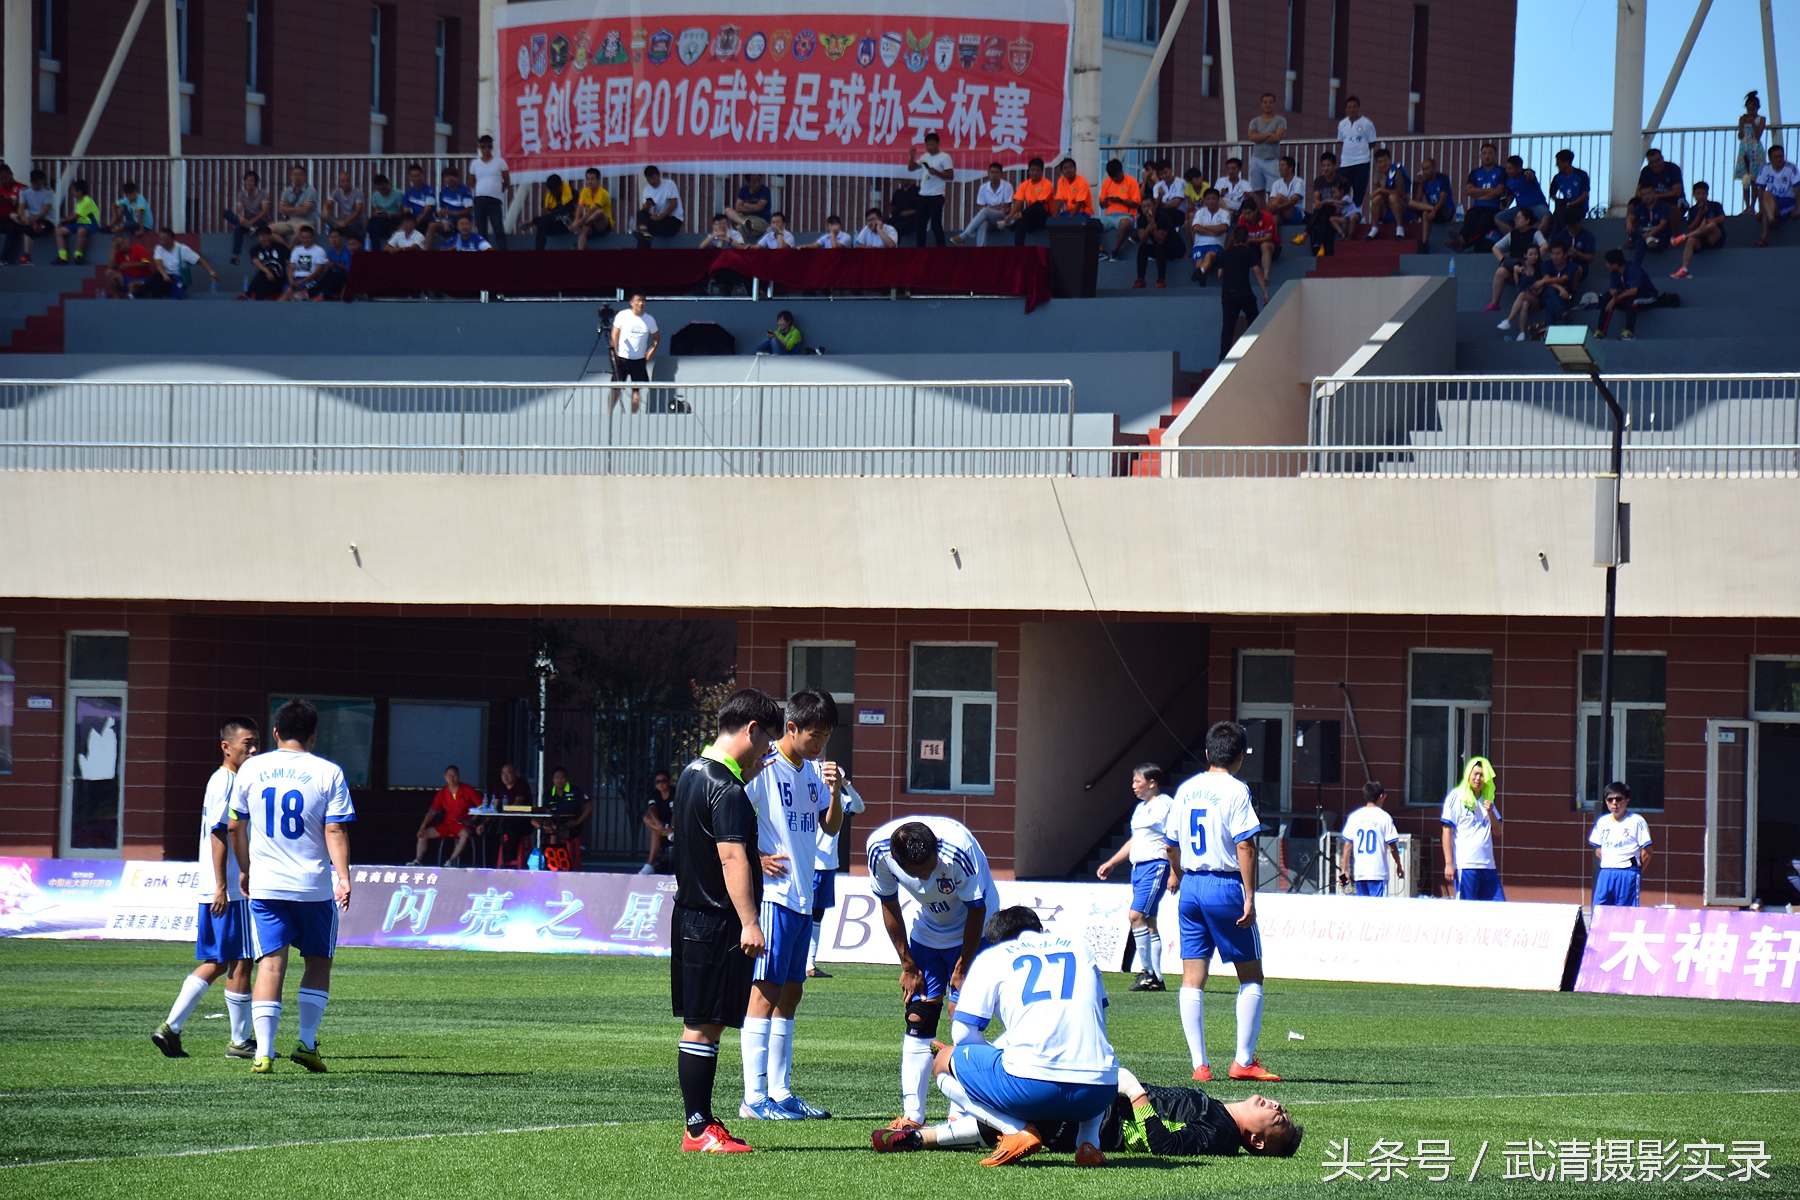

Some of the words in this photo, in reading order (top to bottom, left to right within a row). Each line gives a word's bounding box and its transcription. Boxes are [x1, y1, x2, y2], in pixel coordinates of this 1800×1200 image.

[516, 69, 1032, 156] 首创集团2016武清足球协会杯赛
[261, 787, 305, 840] 18
[777, 781, 793, 808] 15
[787, 810, 816, 833] 君利
[1190, 808, 1208, 857] 5
[1356, 828, 1378, 855] 20
[354, 870, 439, 885] 微商创业平台
[381, 884, 665, 942] 闪亮之星
[1012, 951, 1077, 1007] 27
[1598, 919, 1800, 989] 木神轩
